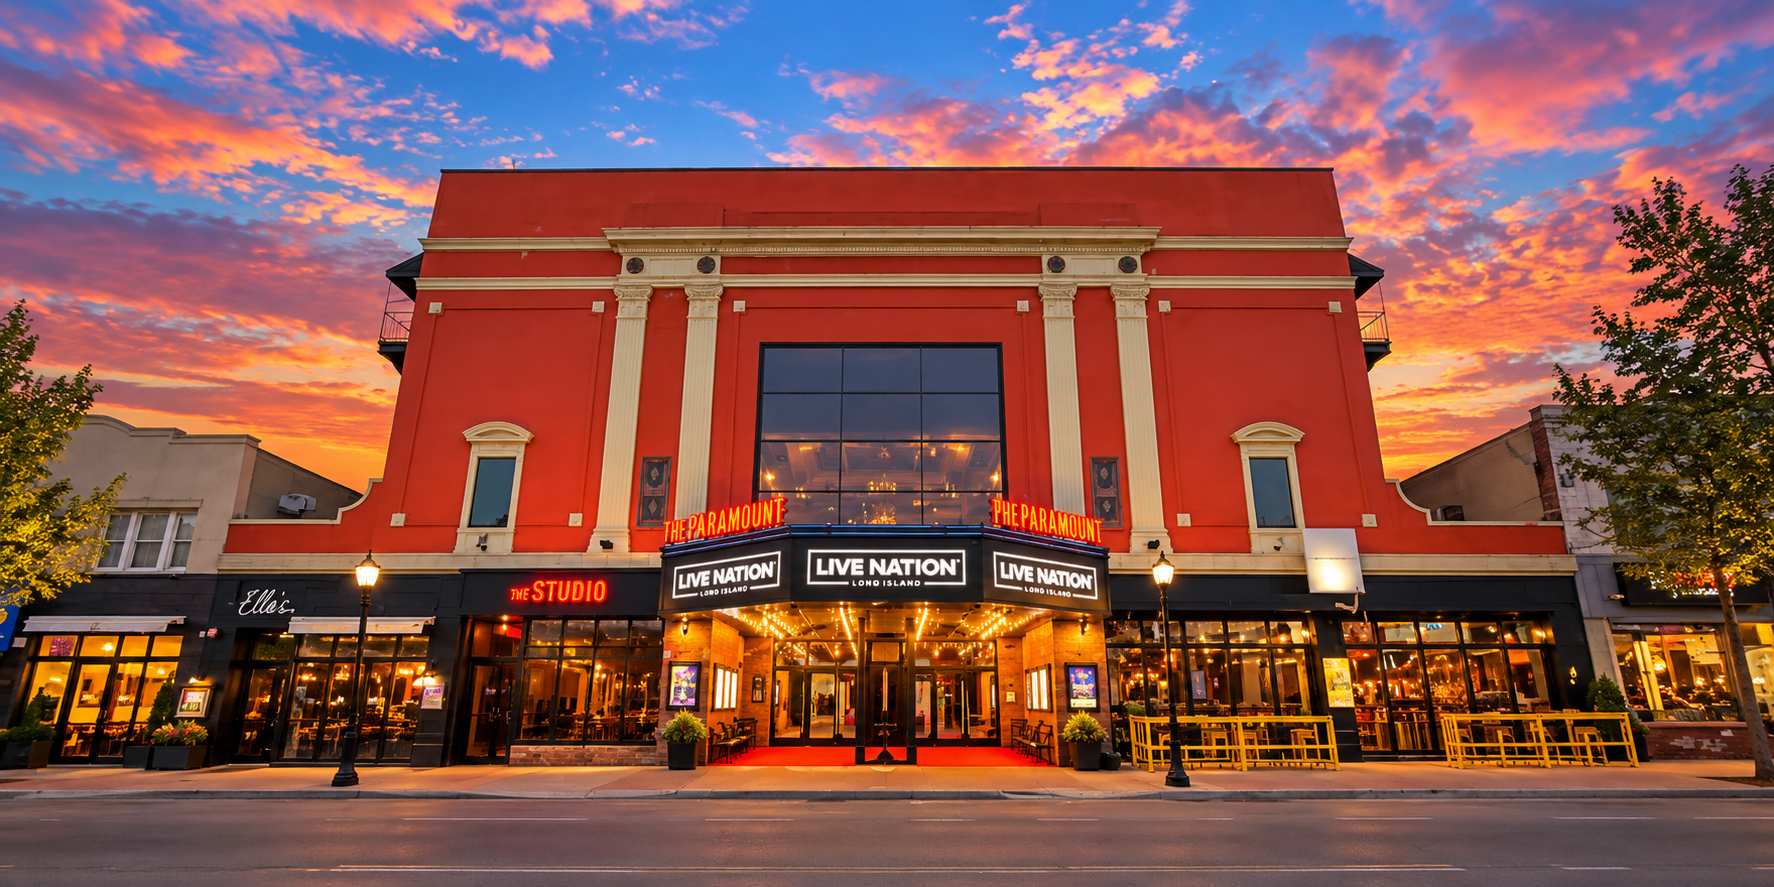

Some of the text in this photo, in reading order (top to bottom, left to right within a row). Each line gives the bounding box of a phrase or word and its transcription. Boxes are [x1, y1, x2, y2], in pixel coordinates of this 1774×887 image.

[663, 497, 785, 542] THE PARAMOUNT
[1020, 503, 1102, 543] PARAMOUNT
[678, 561, 774, 590] LIVE NATION
[816, 558, 957, 576] LIVE NATION
[1000, 561, 1093, 590] LIVE NATION
[531, 579, 607, 602] STUDIO
